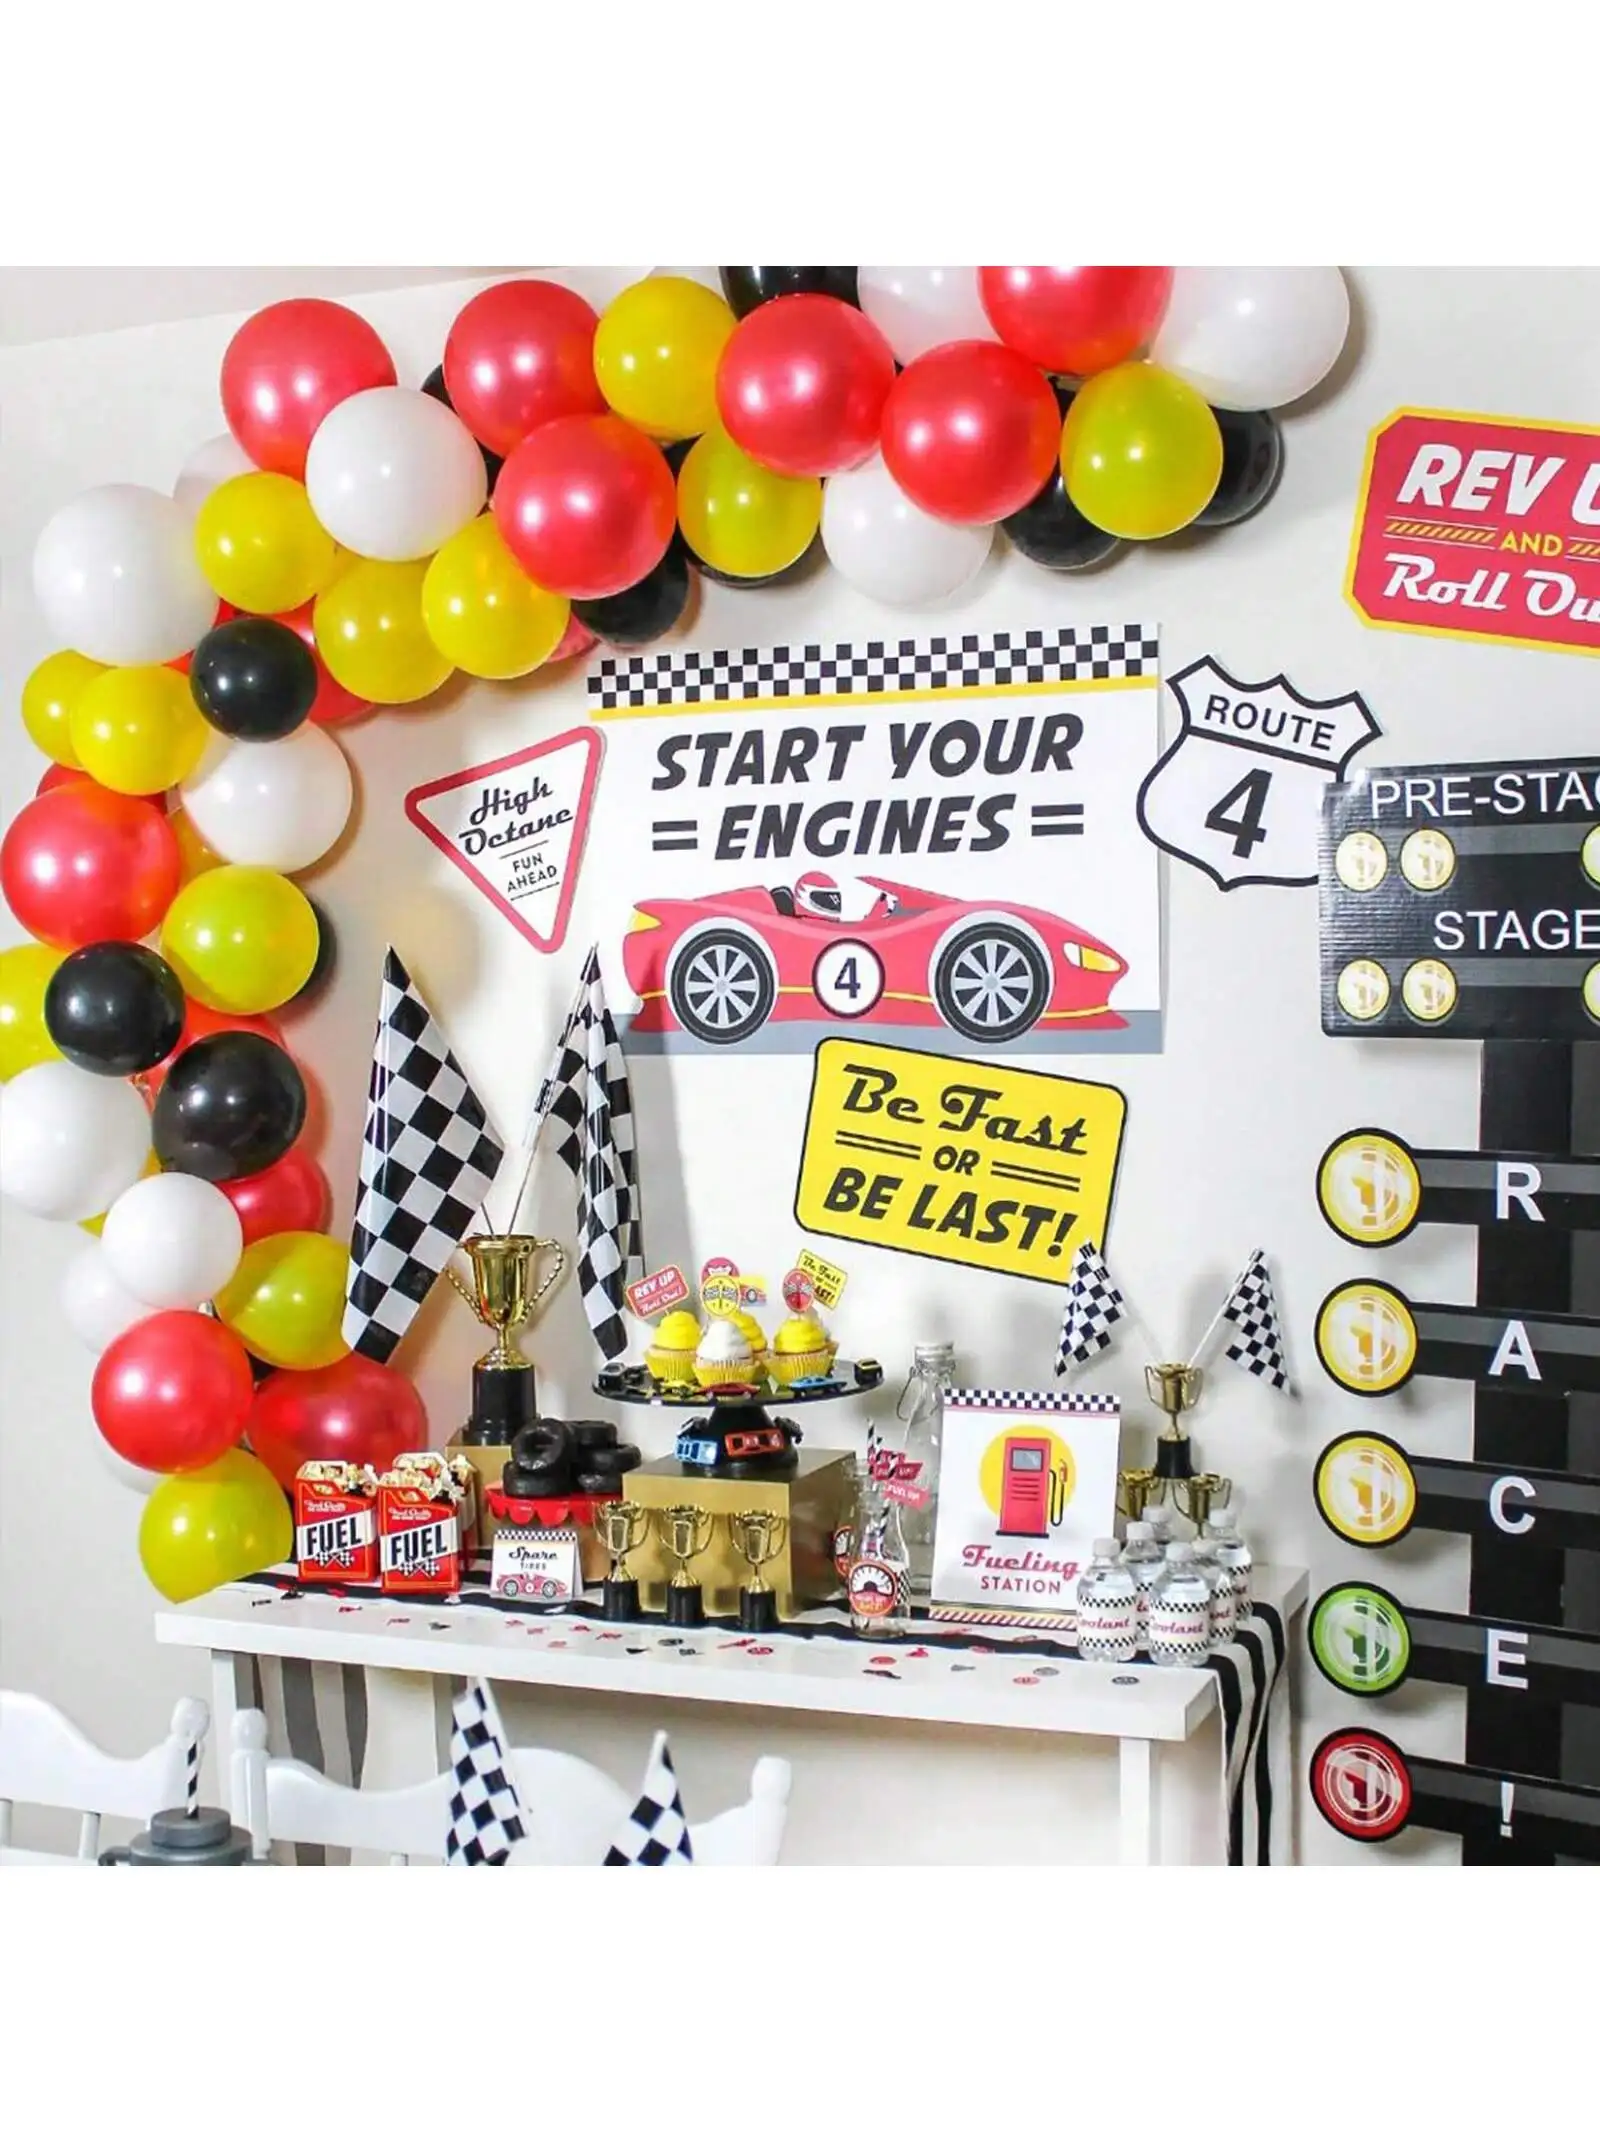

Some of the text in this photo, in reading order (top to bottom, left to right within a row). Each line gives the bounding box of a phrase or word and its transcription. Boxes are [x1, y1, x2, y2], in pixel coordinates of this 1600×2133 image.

[1396, 444, 1567, 515] REV
[1499, 530, 1564, 556] AND
[1382, 552, 1511, 611] Roll
[1204, 695, 1336, 751] ROUTE
[652, 714, 1083, 790] START YOUR
[470, 777, 553, 825] High
[1204, 769, 1273, 860] 4
[1372, 770, 1600, 819] PRE-STA
[459, 809, 573, 855] Octane
[715, 794, 1016, 860] ENGINES
[507, 865, 557, 892] AHEAD
[512, 853, 543, 872] FUN
[1433, 909, 1600, 951] STAGE
[834, 957, 861, 999] 4
[843, 1063, 1087, 1156] Be Fast
[932, 1146, 980, 1176] OR
[822, 1167, 1078, 1258] BE LAST!
[1496, 1161, 1545, 1223] R
[634, 1270, 675, 1300] REV UP
[1488, 1319, 1542, 1381] A
[1489, 1476, 1536, 1535] C
[307, 1516, 362, 1556] FUEL
[391, 1524, 447, 1567] FUEL
[509, 1546, 557, 1561] Spare
[962, 1544, 1081, 1581] Fueling
[981, 1575, 1060, 1594] STATION
[1486, 1629, 1529, 1690] E
[1500, 1782, 1514, 1838] !
